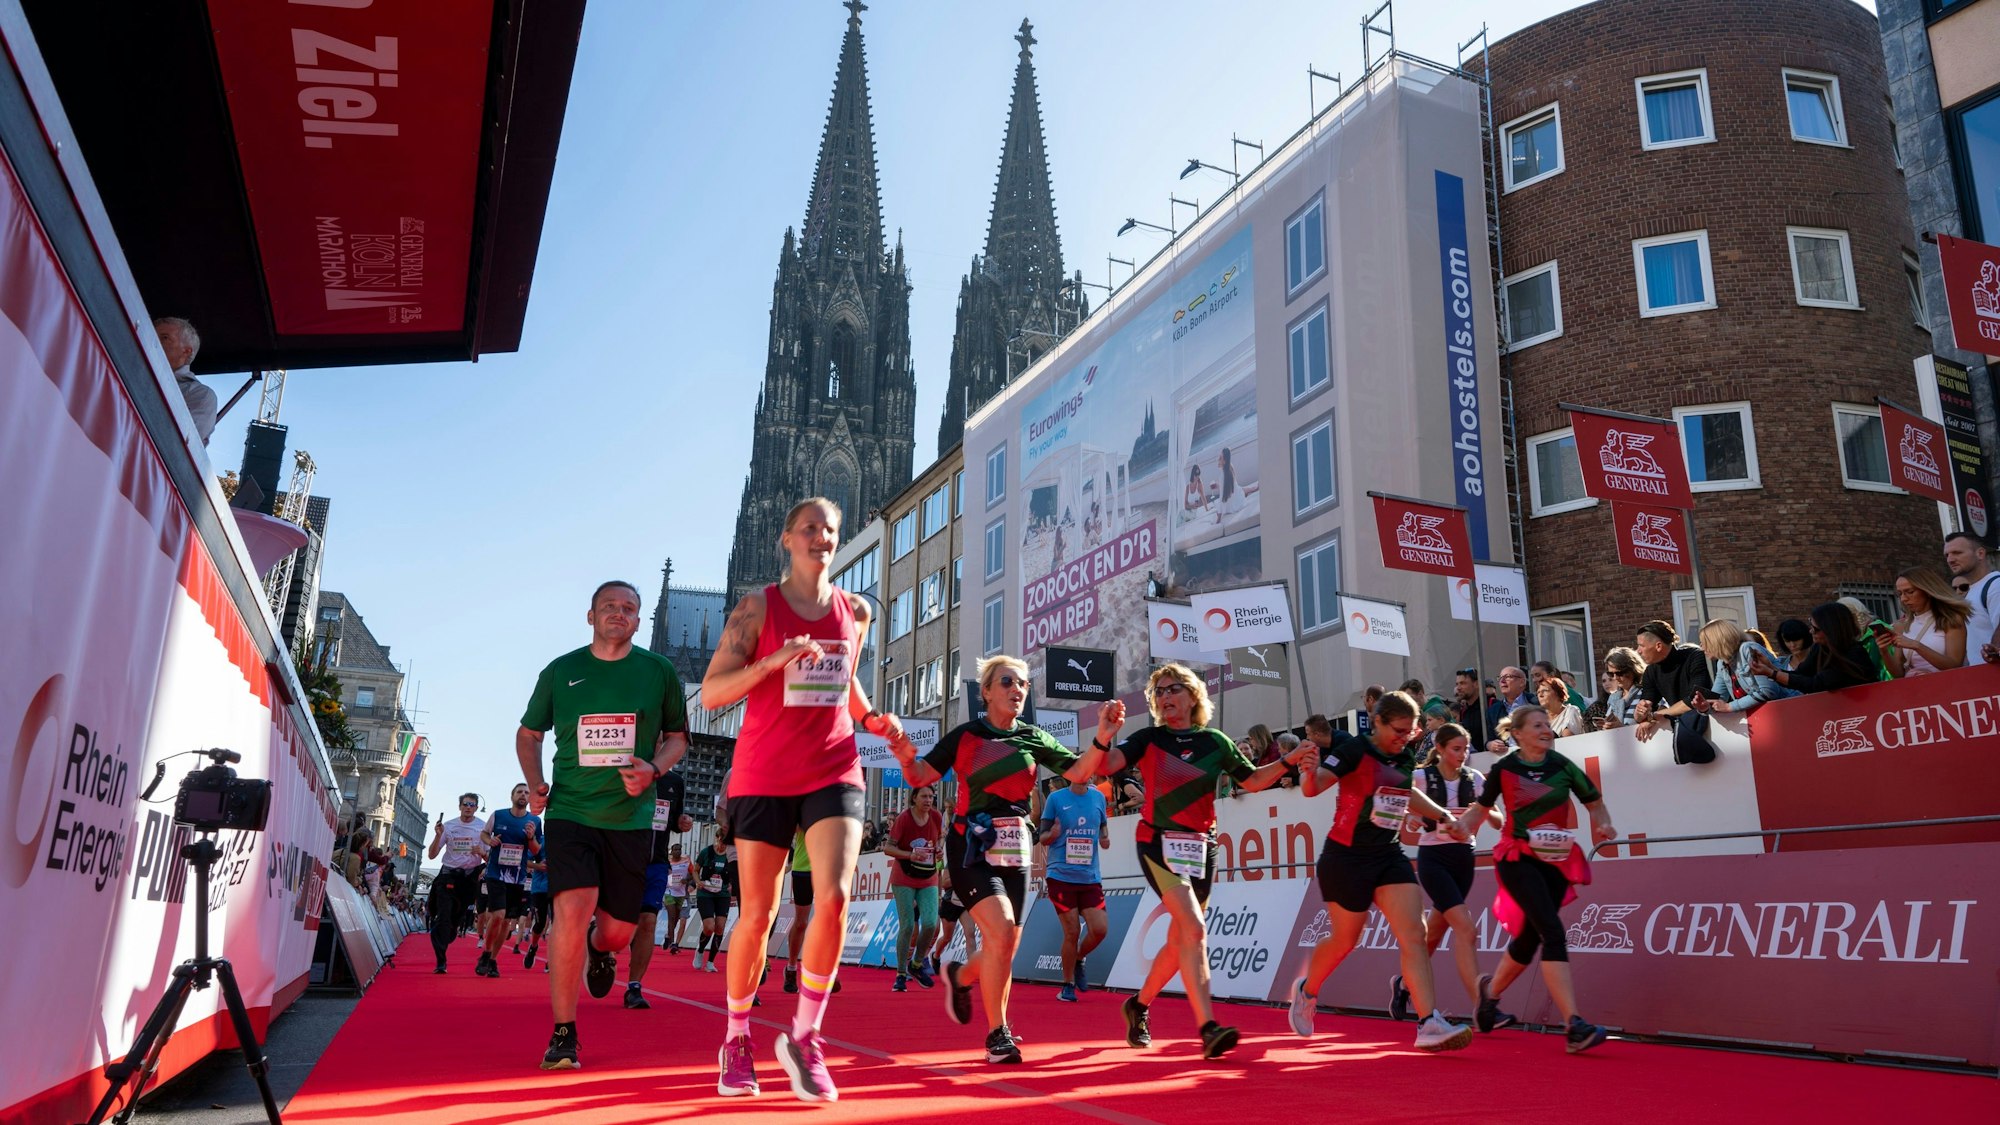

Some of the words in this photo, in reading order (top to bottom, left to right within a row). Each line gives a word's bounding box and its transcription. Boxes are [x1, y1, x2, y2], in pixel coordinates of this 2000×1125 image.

[291, 28, 399, 149] Ziel.
[315, 216, 348, 288] MARATHON
[400, 234, 424, 287] GENERALI
[1173, 325, 1188, 343] Köln
[1190, 311, 1207, 331] Bonn
[1209, 285, 1238, 316] Airport
[1449, 247, 1483, 497] aohostels.com
[1935, 362, 1968, 380] RESTAURANT
[1937, 375, 1954, 389] GREAT
[1954, 379, 1971, 394] WALL
[1029, 391, 1083, 443] Eurowings
[1960, 421, 1976, 433] 2007
[1605, 474, 1669, 495] GENERALI
[1903, 466, 1942, 491] GENERALI
[1400, 548, 1455, 568] GENERALI
[1634, 547, 1680, 565] GENERALI
[1026, 558, 1090, 613] ZORÖCK
[1094, 545, 1115, 581] EN
[1120, 528, 1151, 572] D'R
[1481, 583, 1510, 596] Rhein
[1483, 594, 1520, 607] Energie
[1234, 605, 1269, 618] Rhein
[1236, 614, 1282, 628] Energie
[1027, 611, 1061, 650] DOM
[1066, 597, 1094, 634] REP
[1370, 617, 1393, 629] Rhein
[1372, 627, 1402, 640] Energie
[1240, 667, 1262, 678] FOREVER.
[1263, 670, 1281, 680] FASTER.
[1055, 682, 1082, 692] FOREVER.
[1082, 685, 1105, 693] FASTER.
[1037, 718, 1074, 733] eissdorf
[1875, 695, 2000, 749] GENE
[585, 728, 627, 739] 21231
[63, 723, 128, 808] Rhein
[46, 800, 126, 892] Energie
[1643, 900, 1977, 964] GENERALI
